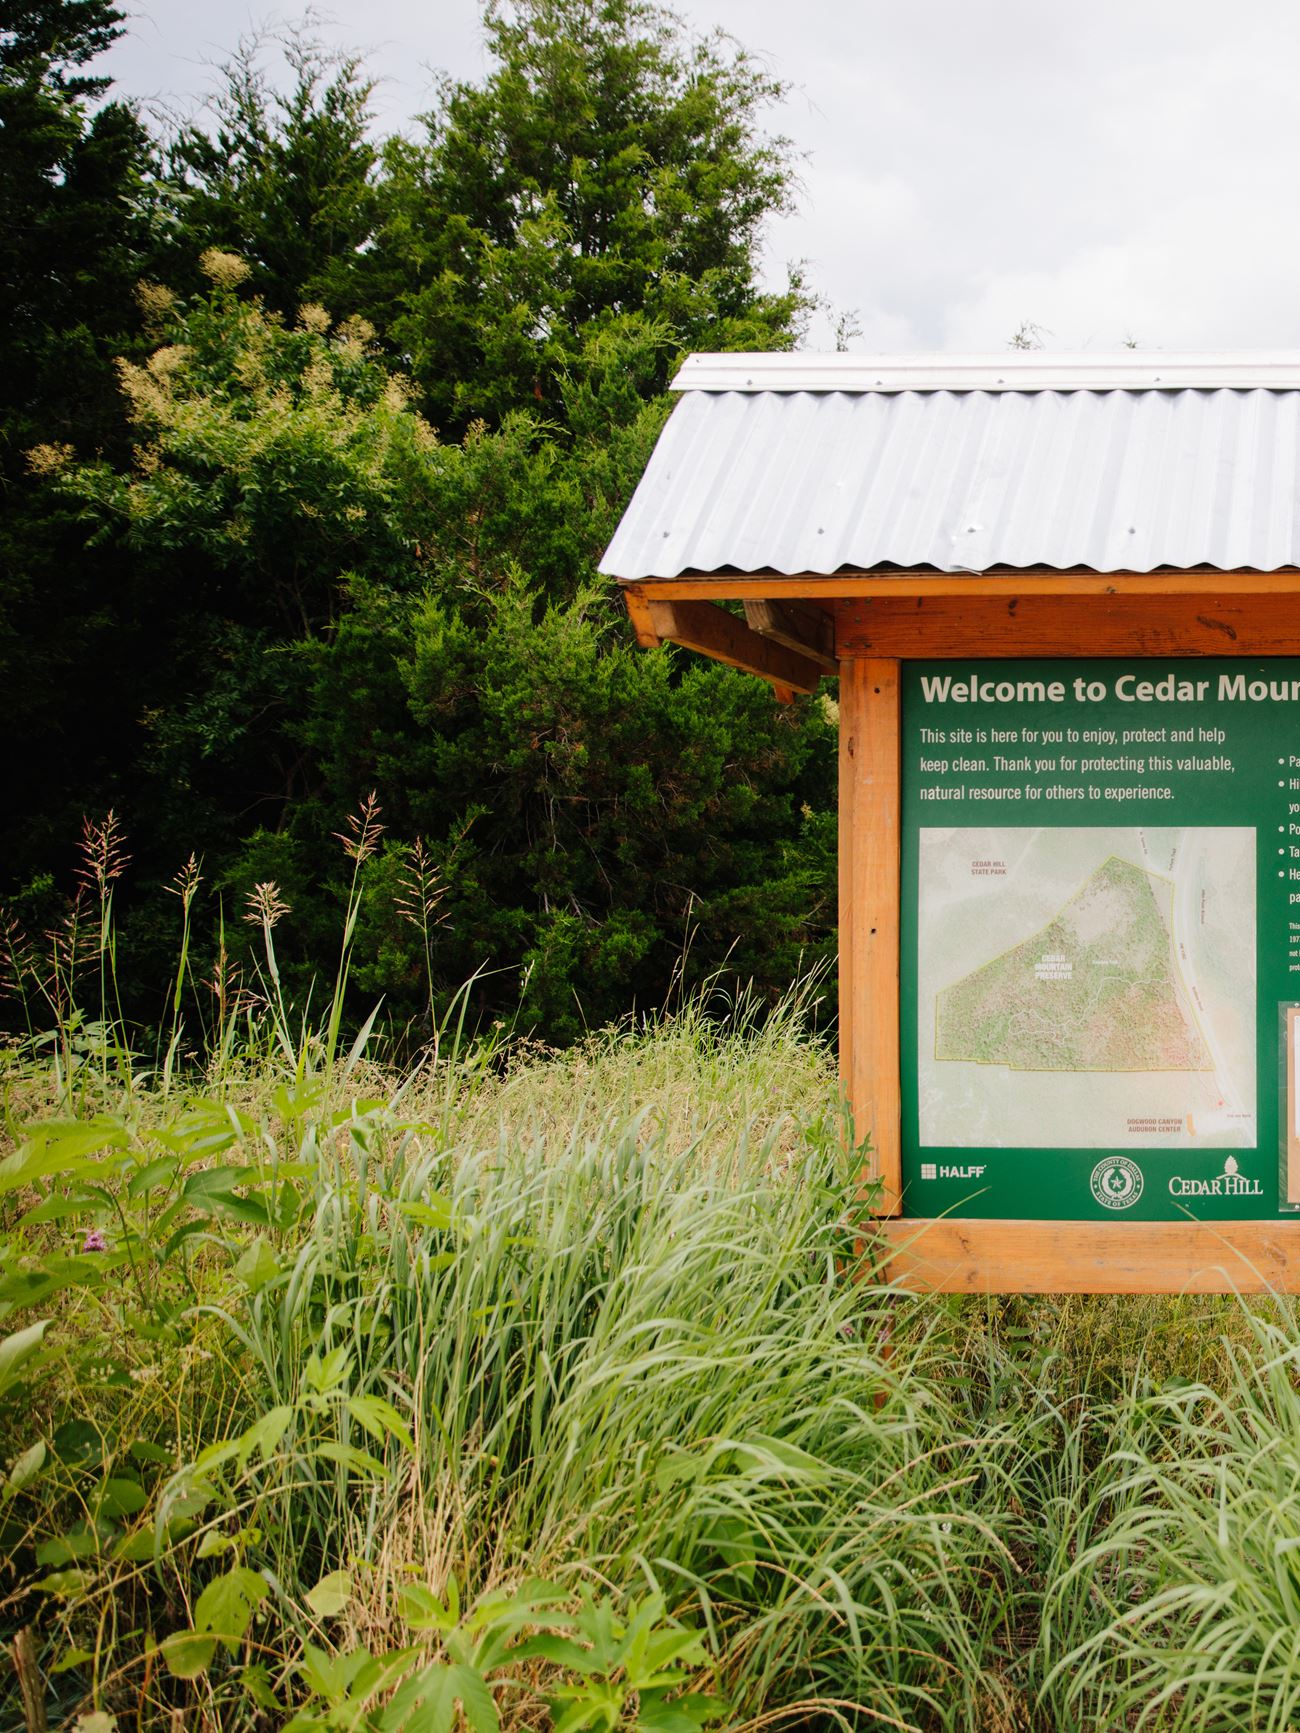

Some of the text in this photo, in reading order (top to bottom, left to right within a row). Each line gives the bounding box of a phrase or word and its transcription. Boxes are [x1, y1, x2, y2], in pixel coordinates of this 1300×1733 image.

[920, 675, 1065, 703] Welcome
[1073, 677, 1107, 702] to
[1115, 674, 1209, 702] Cedar
[920, 727, 1225, 745] This site is here for you to enjoy, protect and help
[920, 756, 1235, 774] keep clean. Thank you for protecting this valuable,
[920, 784, 1174, 802] natural resource for others to experience.
[972, 860, 992, 868] CEDAR
[940, 1165, 985, 1178] HALFF
[1168, 1176, 1264, 1196] CEDAR HILL
